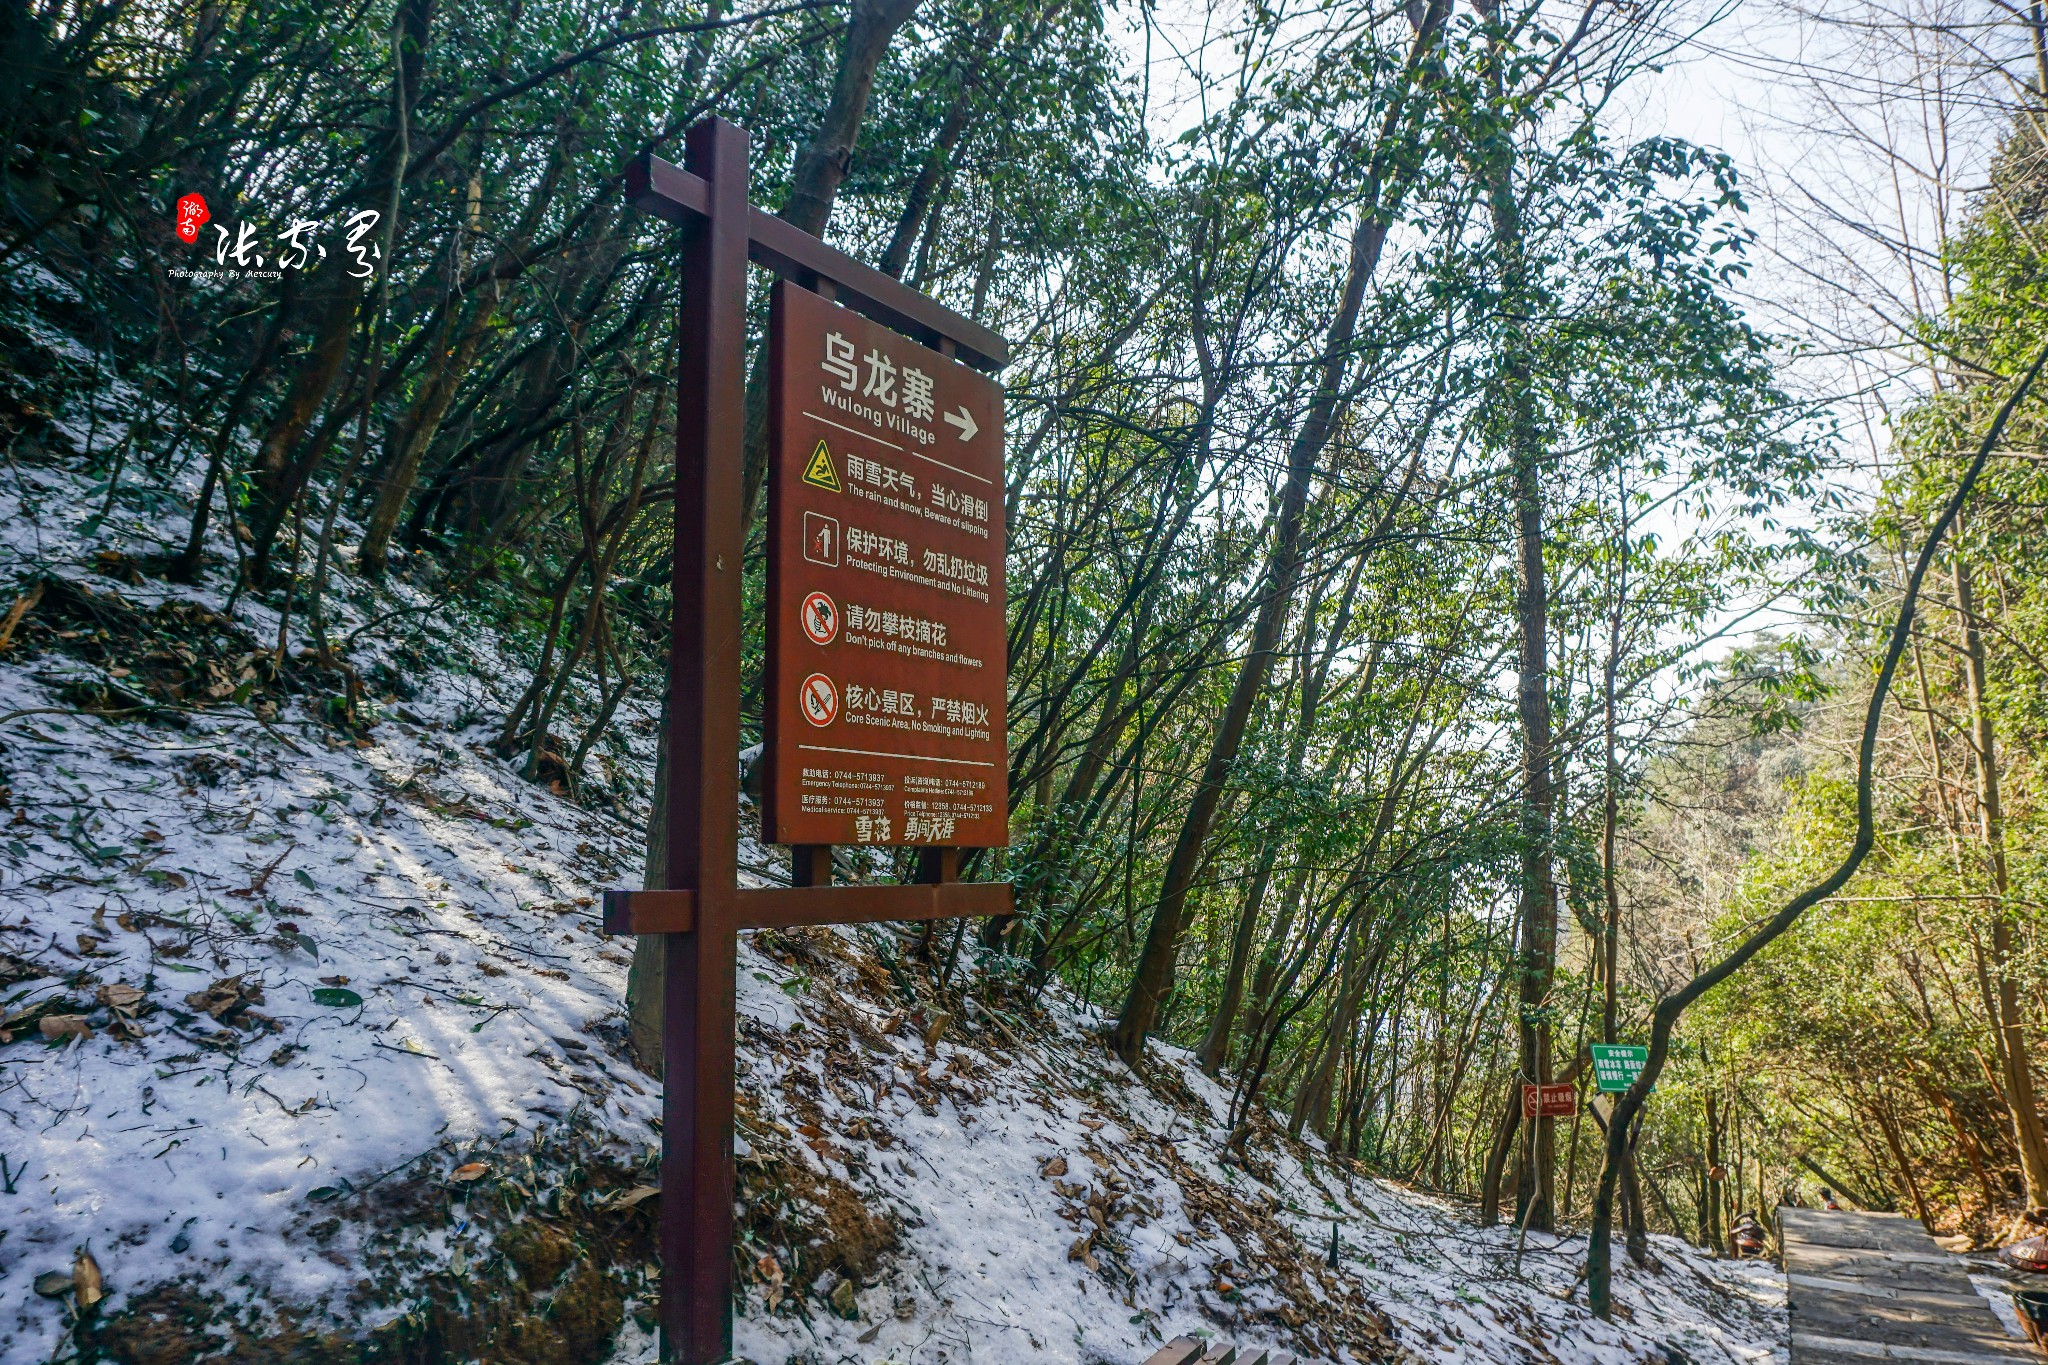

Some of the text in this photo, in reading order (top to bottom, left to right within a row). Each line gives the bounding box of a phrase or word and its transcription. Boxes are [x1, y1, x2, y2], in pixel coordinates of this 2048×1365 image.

[821, 332, 935, 422] 乌龙寨
[821, 385, 936, 444] Wulong Village
[848, 482, 988, 539] The rain and snow, Beware of slipping
[846, 554, 989, 603] Protecting Environment and No Littering
[846, 603, 947, 647] 请勿攀枝摘花
[845, 631, 983, 668] Don't pick off any branches and flowers
[845, 711, 990, 742] Core Scenic Area, No Smoking and Lighting
[855, 815, 955, 842] 雪花 勇闯天涯
[1543, 1091, 1572, 1104] 禁止吸烟
